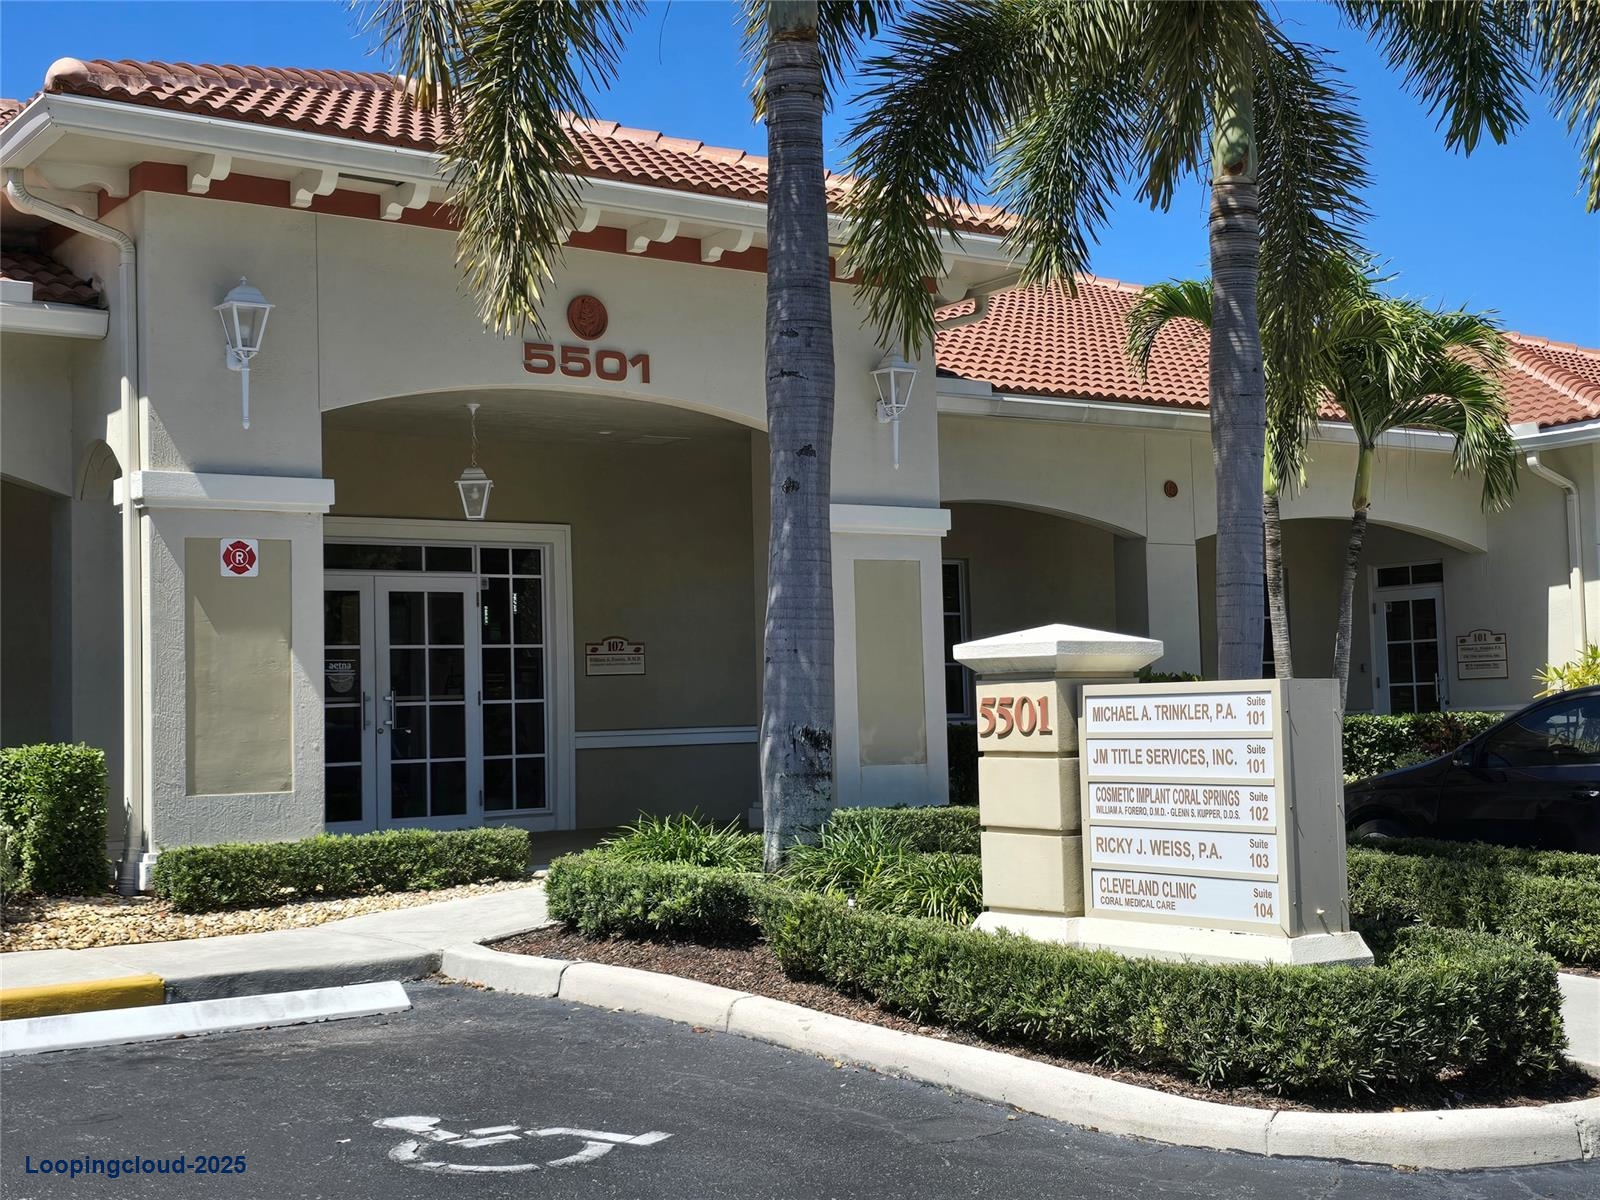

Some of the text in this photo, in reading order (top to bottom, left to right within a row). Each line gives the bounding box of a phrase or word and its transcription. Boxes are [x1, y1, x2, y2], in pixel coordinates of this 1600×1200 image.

[523, 342, 650, 384] 5501
[235, 551, 244, 564] R
[1474, 633, 1487, 642] 101
[608, 641, 625, 652] 102
[328, 662, 352, 670] aetna
[1246, 696, 1266, 706] Suite
[978, 695, 1053, 739] 5501
[1092, 703, 1236, 722] MICHAEL A. TRINKLER, P.A.
[1247, 711, 1265, 725] 101
[1246, 744, 1266, 754] Suite
[1093, 749, 1237, 767] JM TITLE SERVICES, INC.
[1247, 759, 1265, 773] 101
[1096, 786, 1240, 806] COSMETIC IMPLANT CORAL SPRINGS
[1249, 792, 1268, 802] Suite
[1096, 805, 1118, 814] WILLIAM
[1125, 807, 1148, 816] FORERO,
[1150, 808, 1166, 816] D.M.D.
[1171, 809, 1190, 817] GLENN
[1191, 809, 1196, 818] S.
[1197, 809, 1222, 819] KUPPER,
[1224, 810, 1240, 819] D.D.S.
[1250, 806, 1268, 821] 102
[1096, 837, 1222, 860] RICKY J. WEISS, P.A.
[1249, 839, 1268, 848] Suite
[1250, 853, 1269, 868] 103
[1100, 877, 1197, 899] CLEVELAND CLINIC
[1253, 888, 1272, 899] Suite
[1100, 896, 1175, 910] CORAL MEDICAL CARE
[1254, 903, 1273, 918] 104
